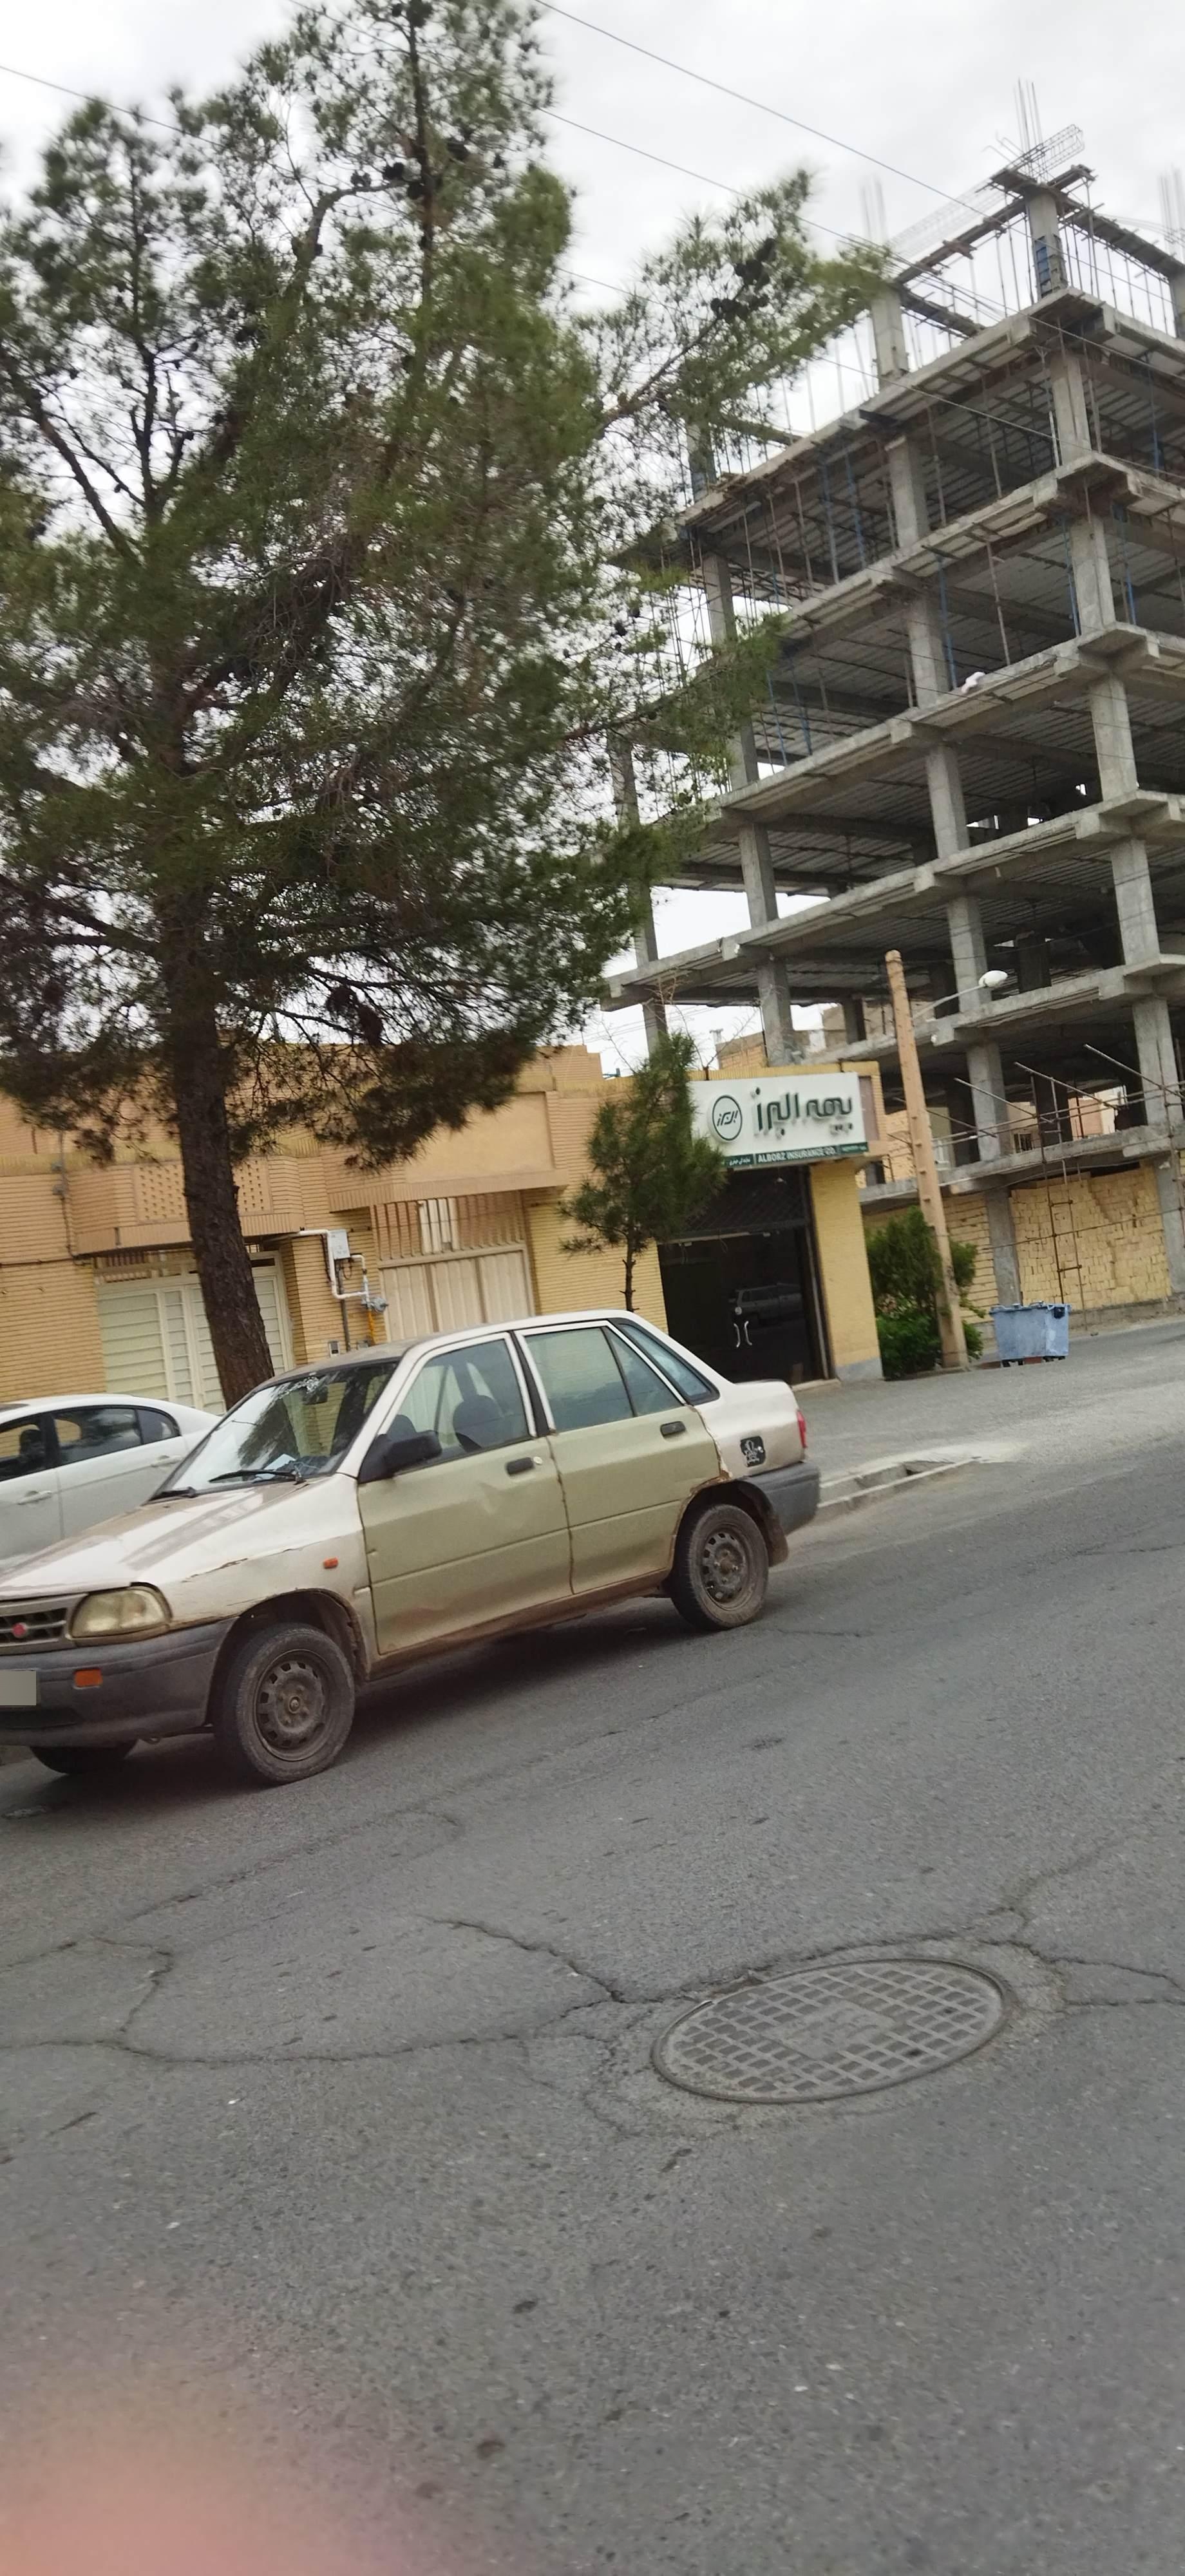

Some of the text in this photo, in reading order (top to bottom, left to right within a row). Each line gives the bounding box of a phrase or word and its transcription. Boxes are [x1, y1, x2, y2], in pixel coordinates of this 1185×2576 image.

[755, 1087, 853, 1135] بیمه البرز
[757, 1151, 786, 1163] ALBORZ
[786, 1148, 824, 1159] INSURANCE
